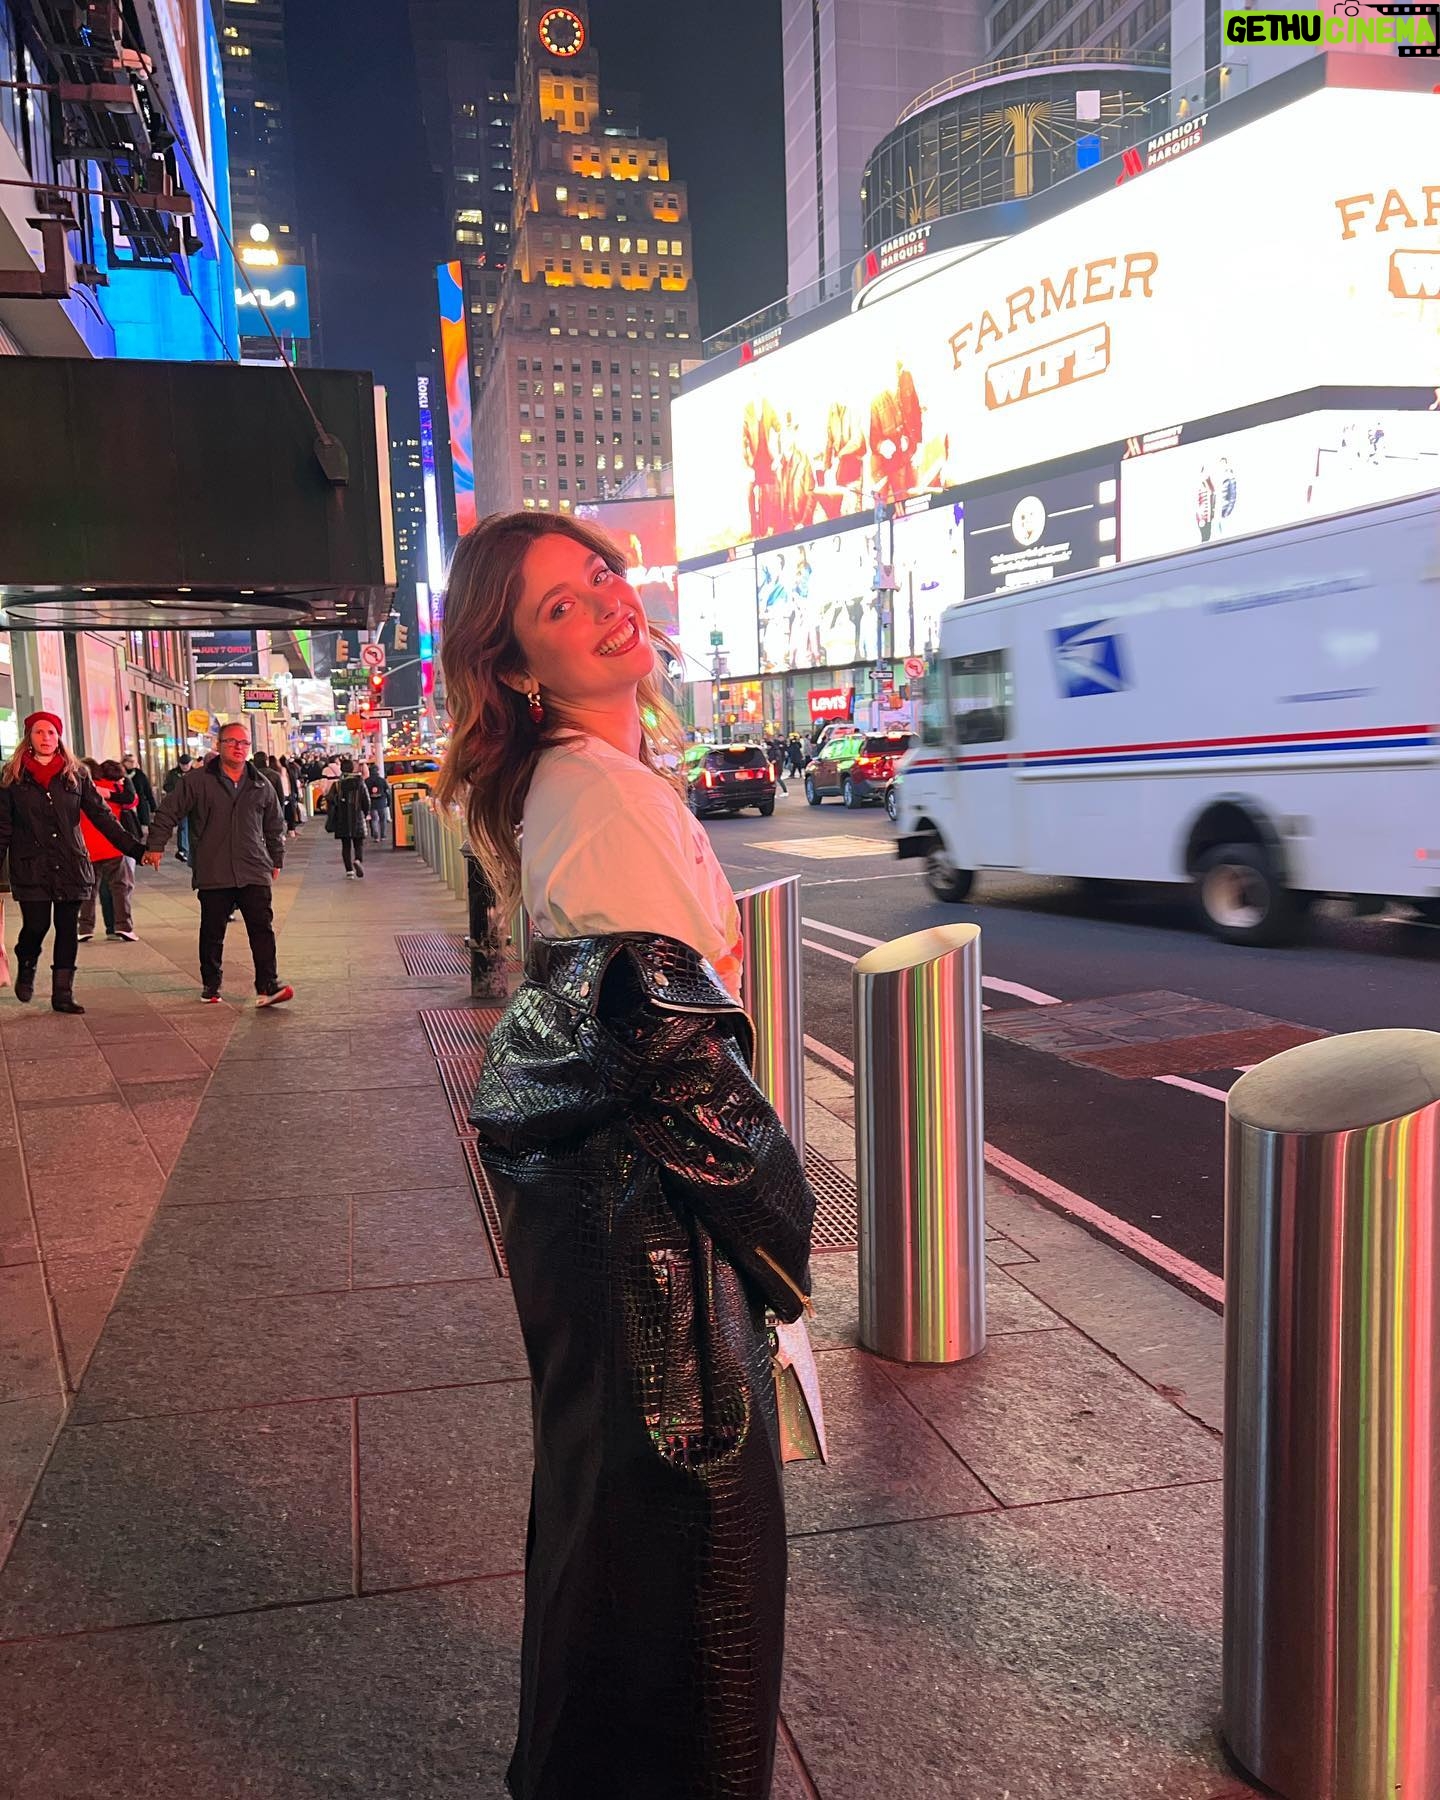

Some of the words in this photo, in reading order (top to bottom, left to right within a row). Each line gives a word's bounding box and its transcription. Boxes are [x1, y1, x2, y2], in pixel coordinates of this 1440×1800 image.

[1147, 132, 1201, 166] MARQUIS
[1148, 113, 1208, 152] MARRIOTT
[880, 225, 932, 256] MARRIOTT
[880, 242, 925, 269] MARQUIS
[948, 251, 1159, 370] FARMER
[987, 325, 1107, 405] WIFE
